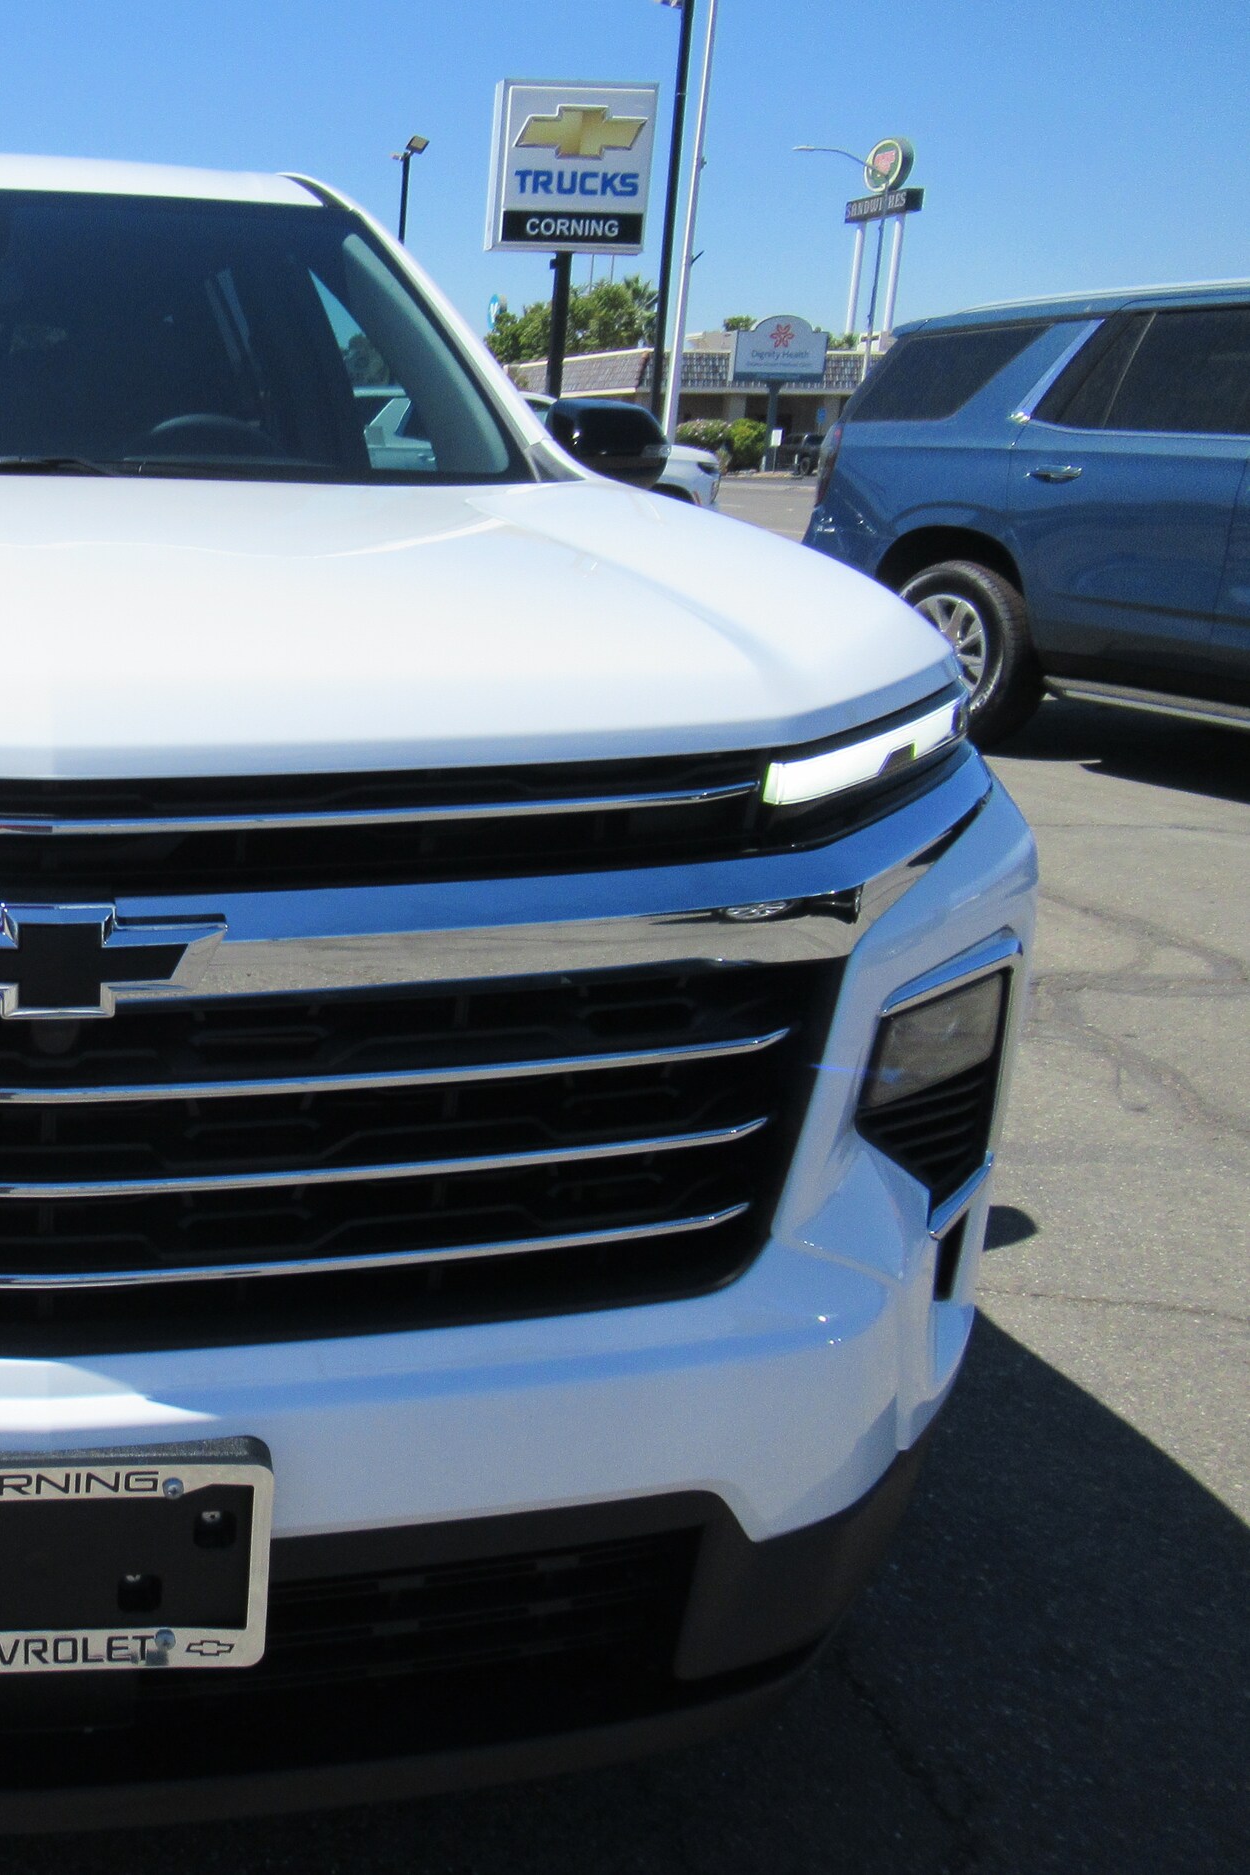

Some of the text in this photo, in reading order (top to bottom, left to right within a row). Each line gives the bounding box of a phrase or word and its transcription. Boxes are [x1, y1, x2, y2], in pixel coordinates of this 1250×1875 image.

[514, 169, 640, 197] TRUCKS
[845, 191, 907, 218] SANDWIHES
[526, 217, 620, 238] CORNING
[751, 349, 810, 361] Dignity Health
